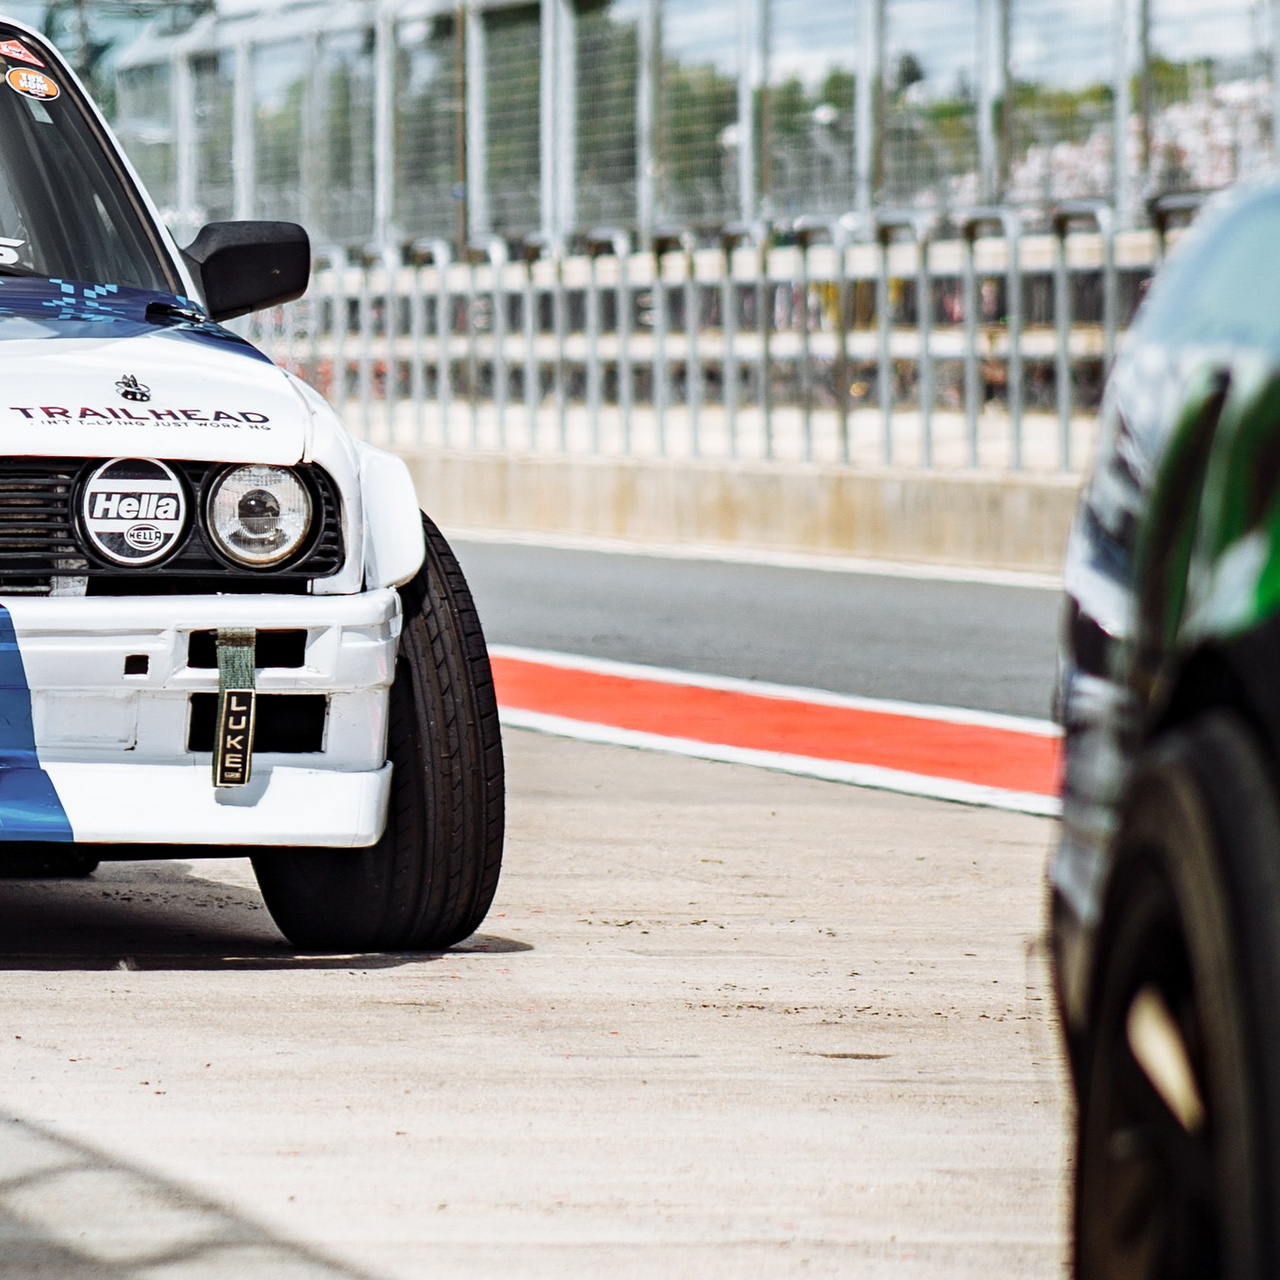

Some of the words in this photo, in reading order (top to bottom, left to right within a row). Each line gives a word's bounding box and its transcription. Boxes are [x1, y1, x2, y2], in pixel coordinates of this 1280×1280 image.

[10, 406, 270, 424] TRAILHEAD
[195, 422, 271, 431] WORKNG
[92, 493, 178, 520] Hella
[129, 530, 162, 541] HELLA
